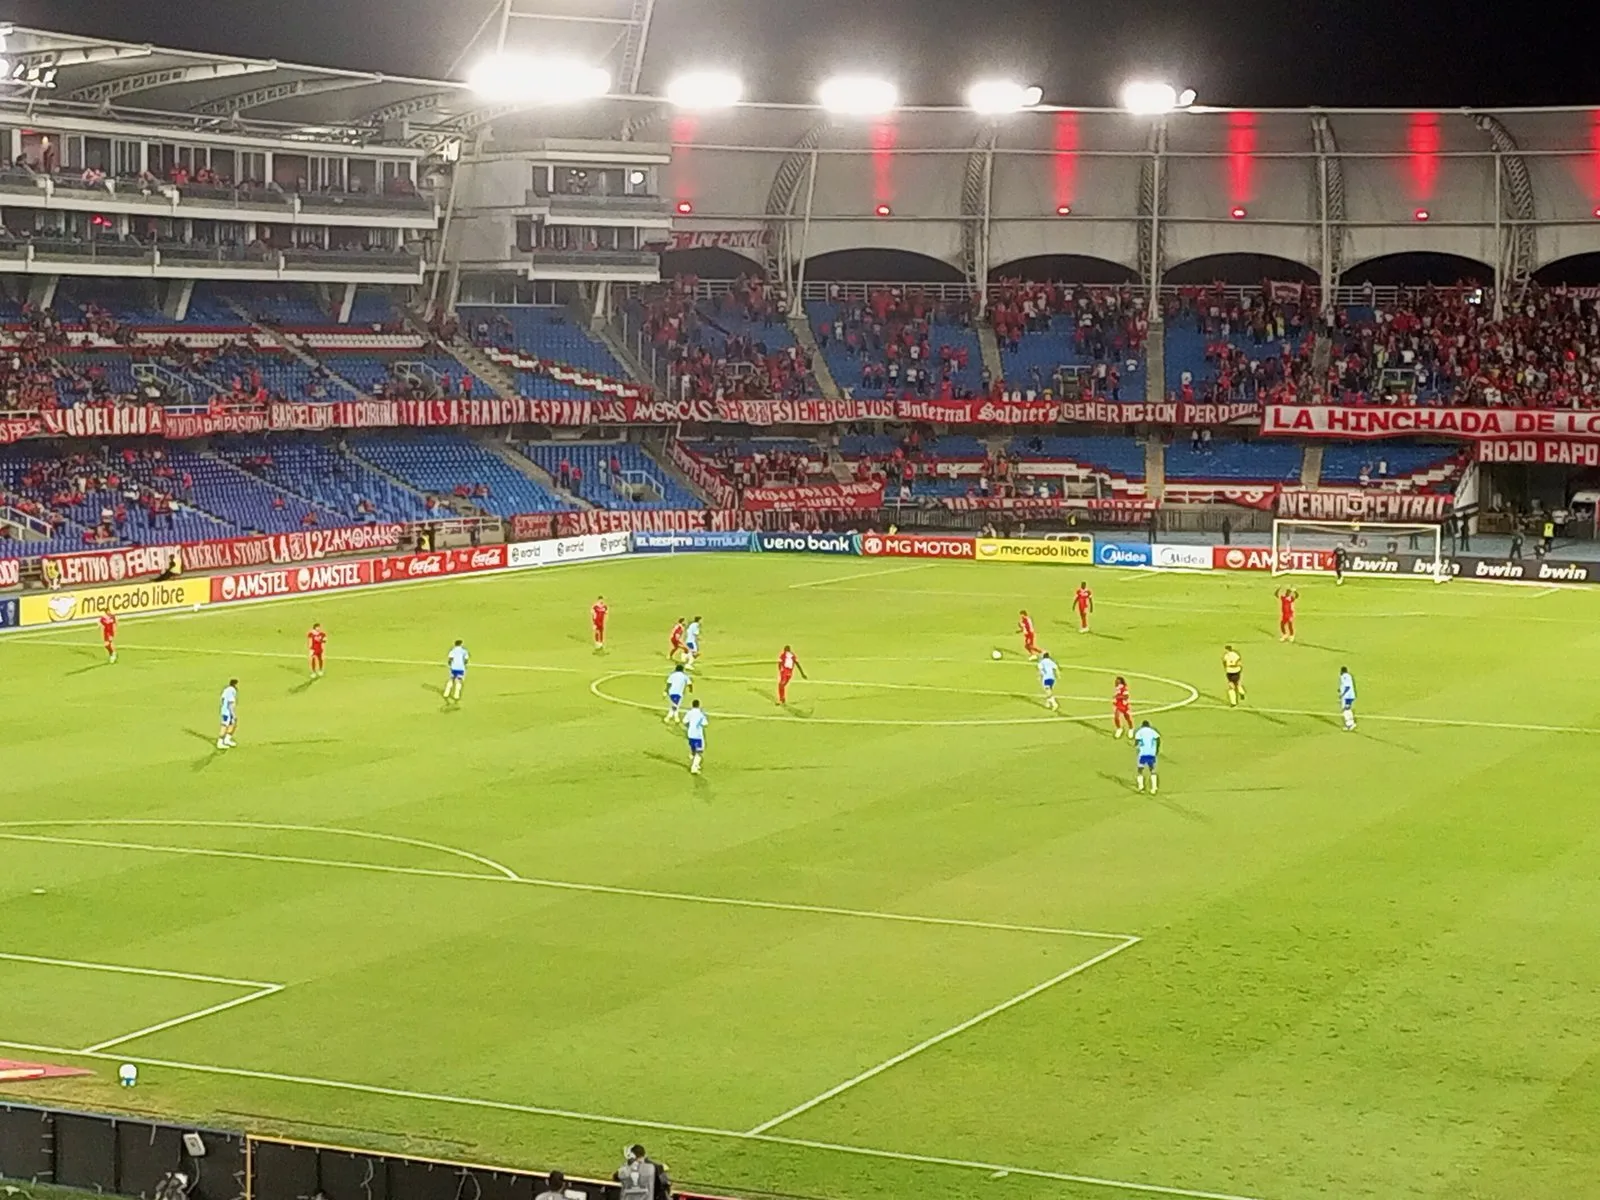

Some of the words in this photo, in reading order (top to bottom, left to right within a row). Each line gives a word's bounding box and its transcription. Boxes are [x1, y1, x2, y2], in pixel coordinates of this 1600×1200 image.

[271, 404, 334, 428] BARCELONA
[600, 402, 627, 422] LAS
[898, 401, 972, 422] Infernal
[1062, 403, 1178, 423] GENERACION
[1272, 407, 1313, 430] LA
[1327, 409, 1503, 434] HINCHADA
[1514, 413, 1556, 433] DE
[1479, 440, 1538, 462] ROJO
[1543, 441, 1599, 466] CAPO
[1278, 493, 1347, 517] AVERNO
[1364, 494, 1444, 519] CENTRAL
[601, 509, 689, 533] FERNANDO
[234, 539, 269, 566] STORE
[269, 535, 291, 564] LA
[304, 530, 326, 560] 12
[763, 537, 805, 550] ueno
[807, 535, 850, 551] bank
[885, 539, 911, 553] MG
[914, 541, 973, 556] MOTOR
[1000, 544, 1058, 557] mercado
[1060, 546, 1089, 558] libre
[1110, 549, 1148, 563] Midea
[1169, 552, 1205, 564] Midea
[1246, 550, 1324, 570] AMSTEL
[1352, 556, 1399, 573] bwin
[310, 561, 361, 589] AMSTEL
[1475, 561, 1523, 578] bwin
[1539, 563, 1588, 580] bwin
[236, 571, 289, 600] AMSTEL
[81, 587, 150, 614] mercado
[152, 585, 185, 606] libre
